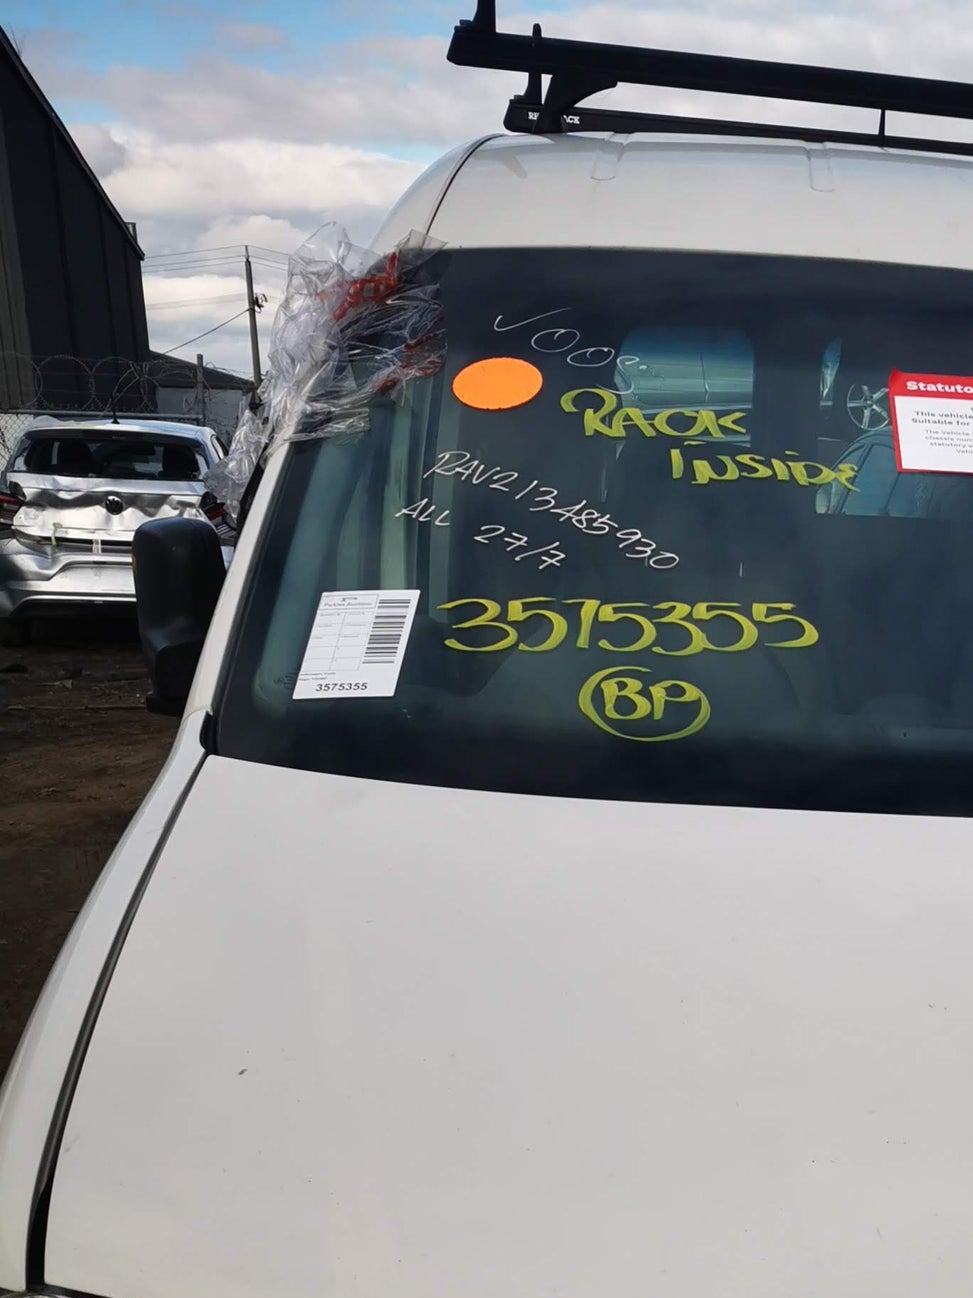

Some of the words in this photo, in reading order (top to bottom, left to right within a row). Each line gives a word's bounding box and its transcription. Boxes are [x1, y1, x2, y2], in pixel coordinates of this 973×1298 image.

[915, 410, 936, 418] This
[938, 412, 973, 420] vehicle
[911, 417, 954, 426] Suitable
[956, 419, 971, 427] for
[436, 596, 820, 657] 3575355
[315, 682, 369, 692] 3575355
[600, 676, 702, 721] BP
